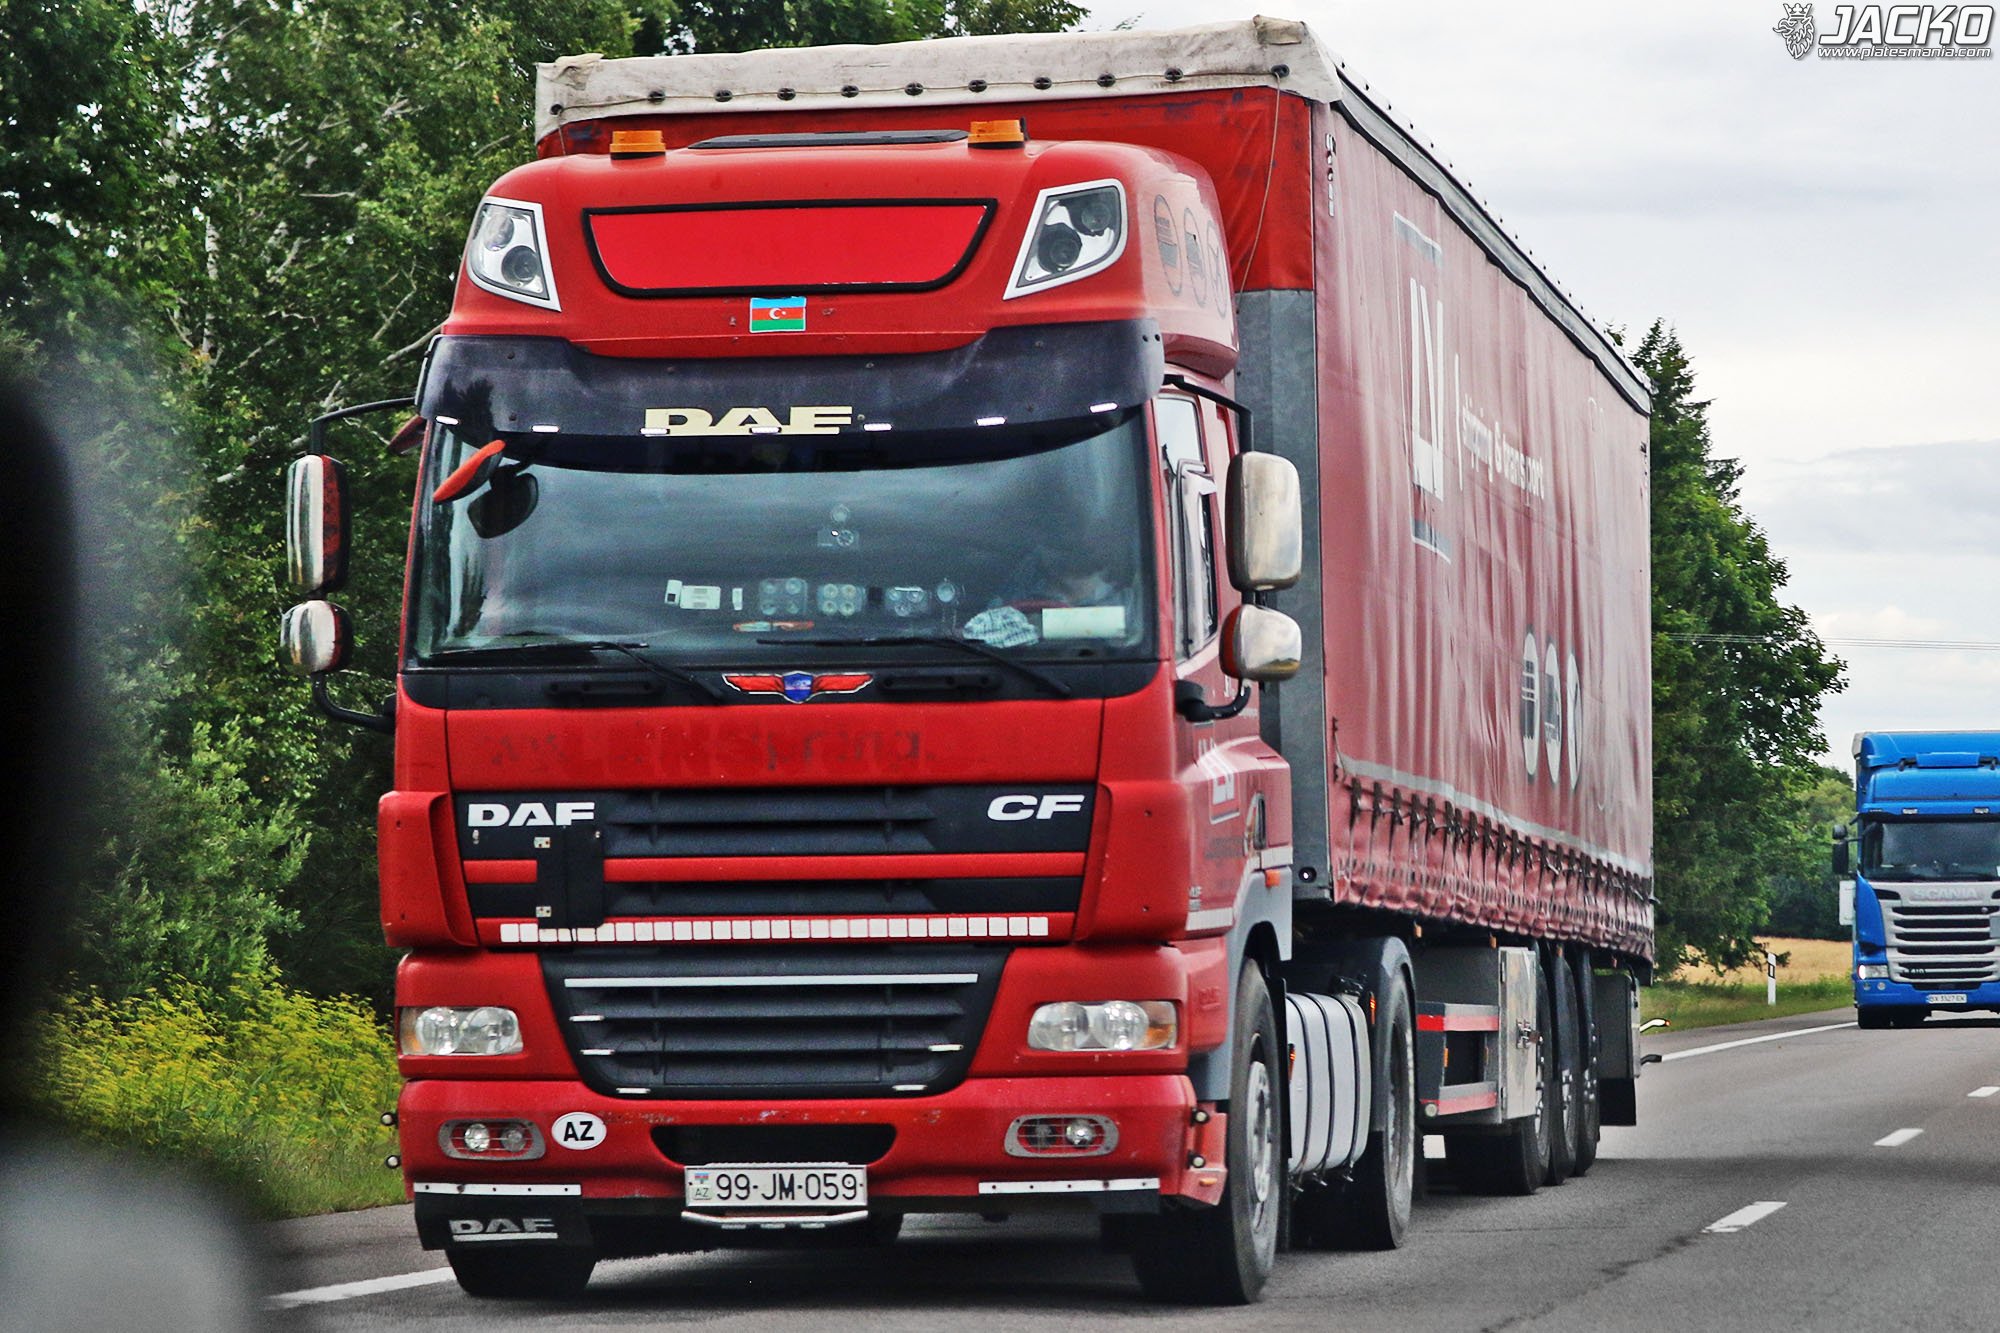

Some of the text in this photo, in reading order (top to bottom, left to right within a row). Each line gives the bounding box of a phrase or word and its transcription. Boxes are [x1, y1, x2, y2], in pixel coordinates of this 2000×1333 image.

[643, 405, 853, 438] DAF
[467, 801, 596, 829] DAF
[986, 793, 1086, 821] CF
[563, 1120, 596, 1142] AZ
[694, 1173, 858, 1201] AZ 99-JM-059
[448, 1218, 555, 1234] DAF
